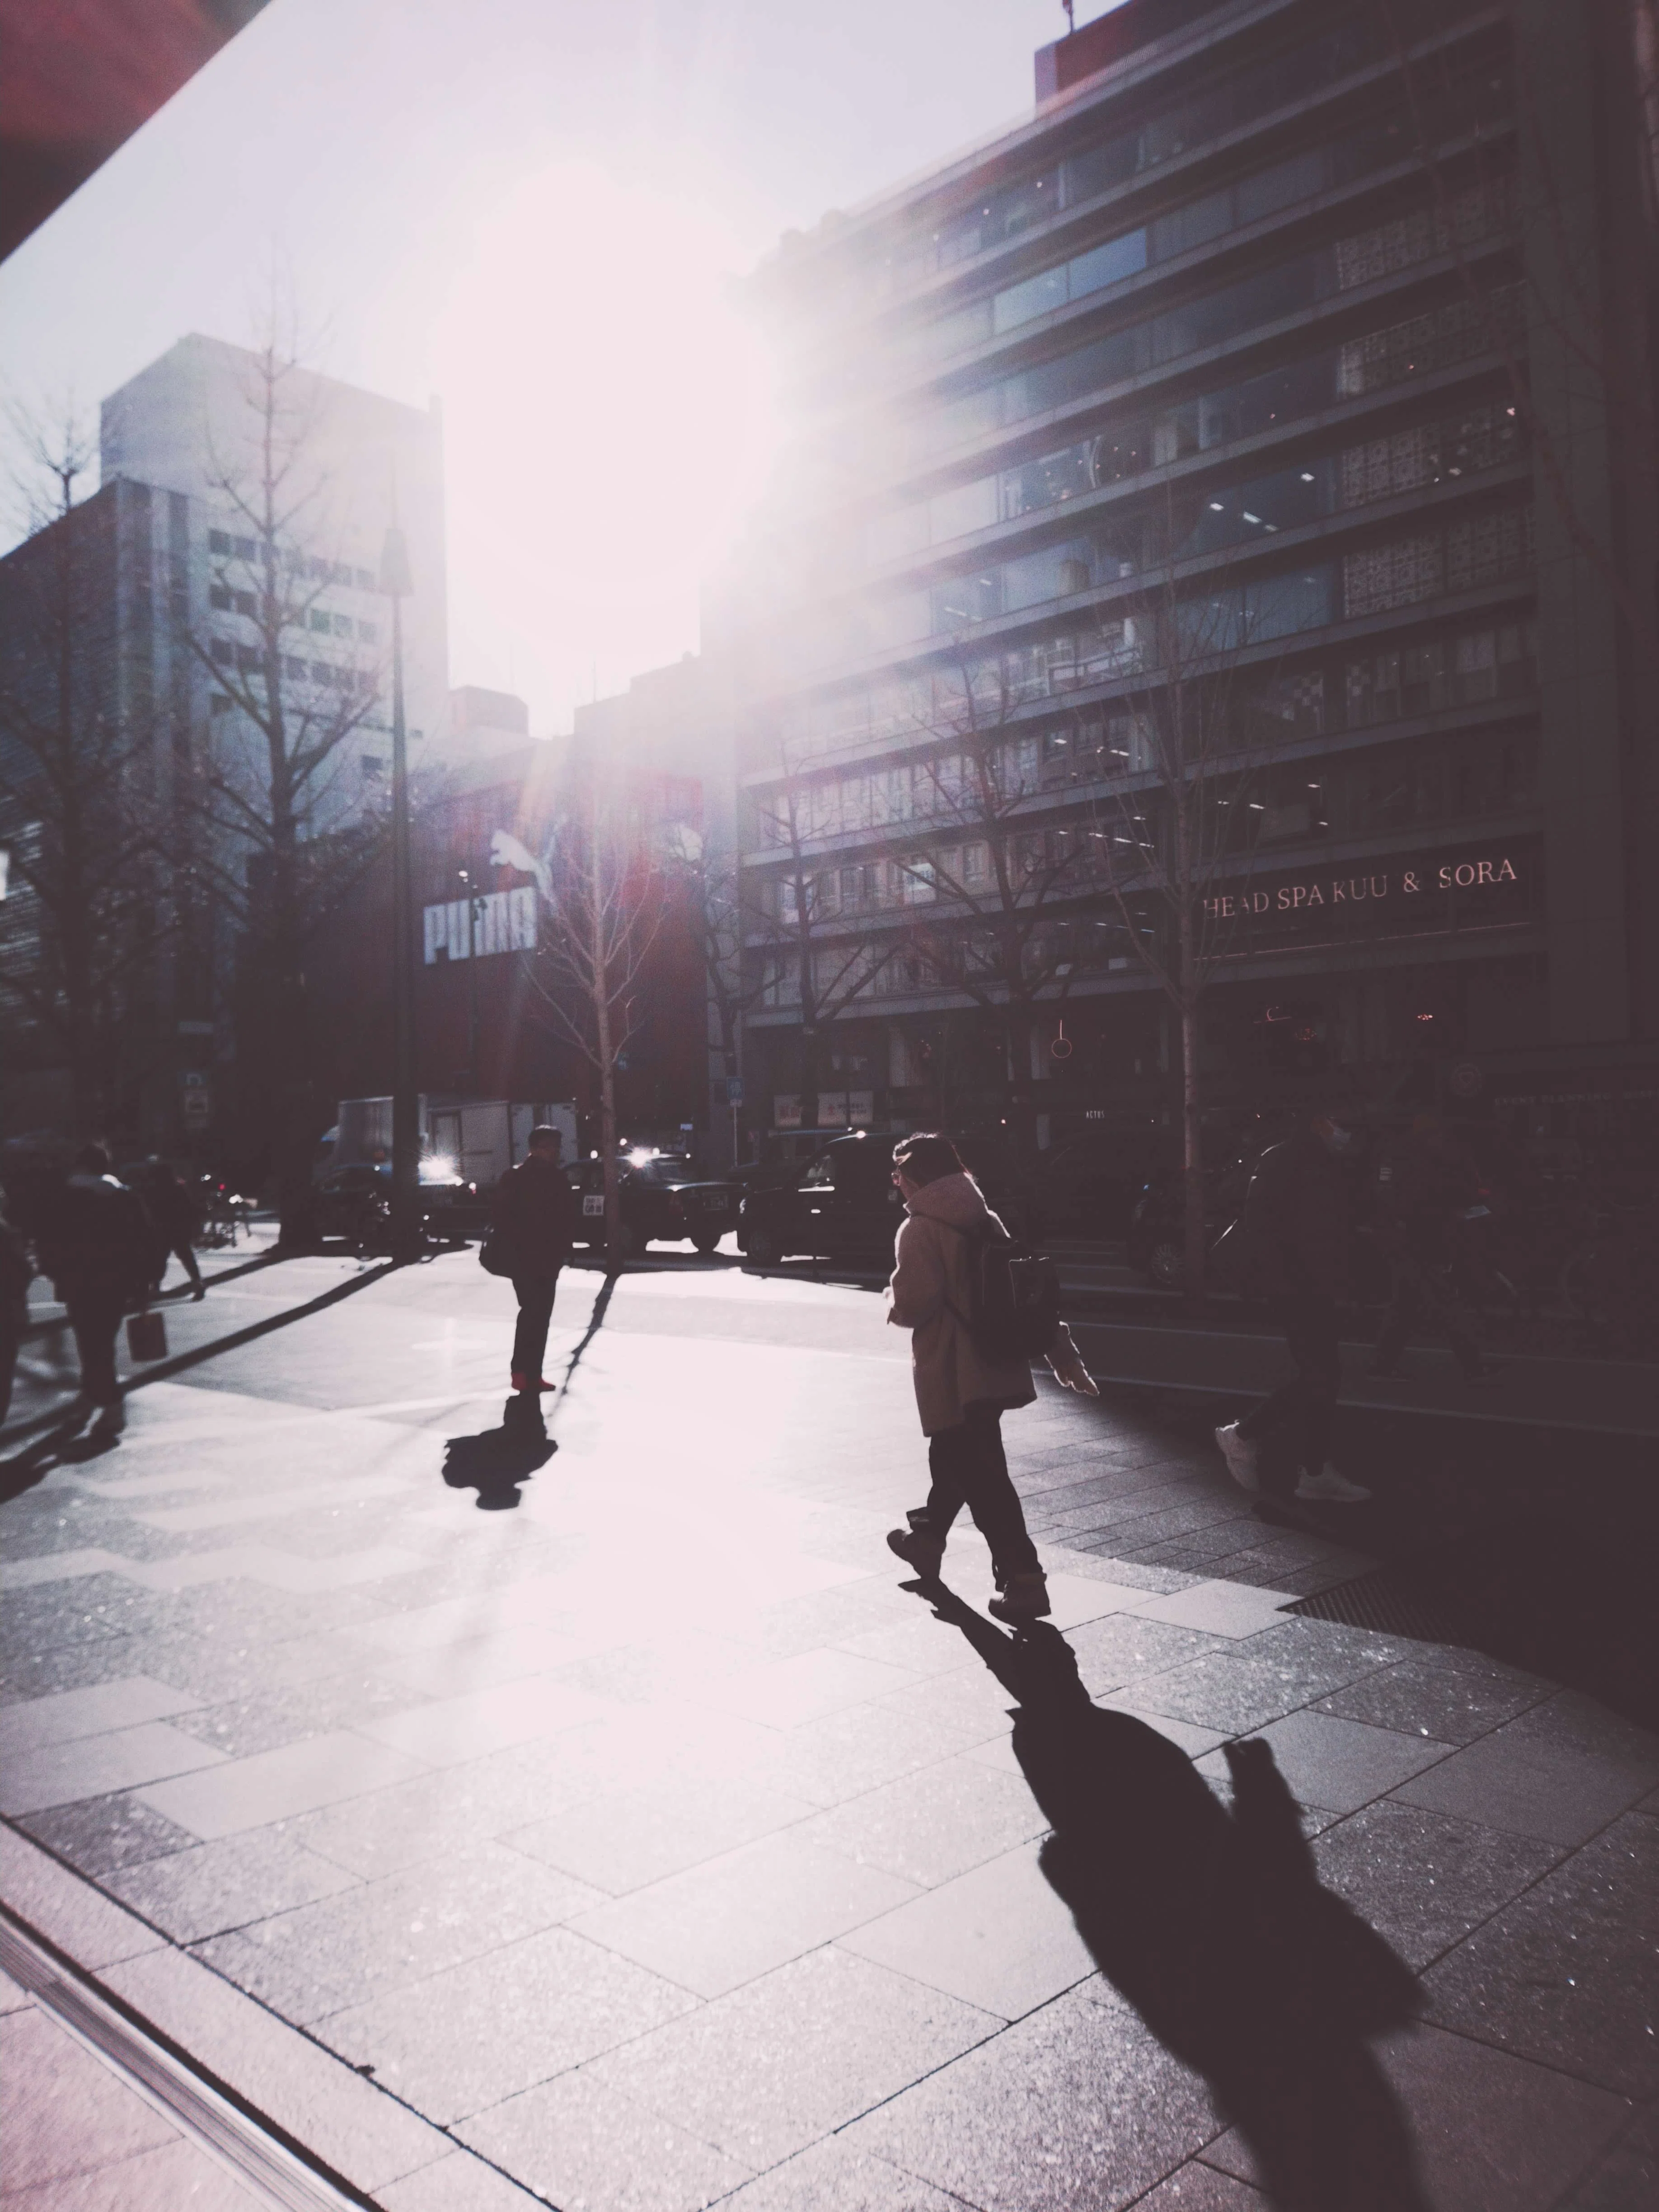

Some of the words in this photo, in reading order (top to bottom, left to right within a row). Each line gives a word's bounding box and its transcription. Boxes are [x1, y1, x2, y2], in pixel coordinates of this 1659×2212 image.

[1203, 892, 1270, 919] HEAD
[1278, 884, 1325, 909] SPA
[1332, 876, 1388, 903] KUU
[1403, 871, 1421, 893] &
[1439, 858, 1518, 889] SORA
[423, 886, 537, 965] PUMA
[1086, 1110, 1105, 1119] ACTUS
